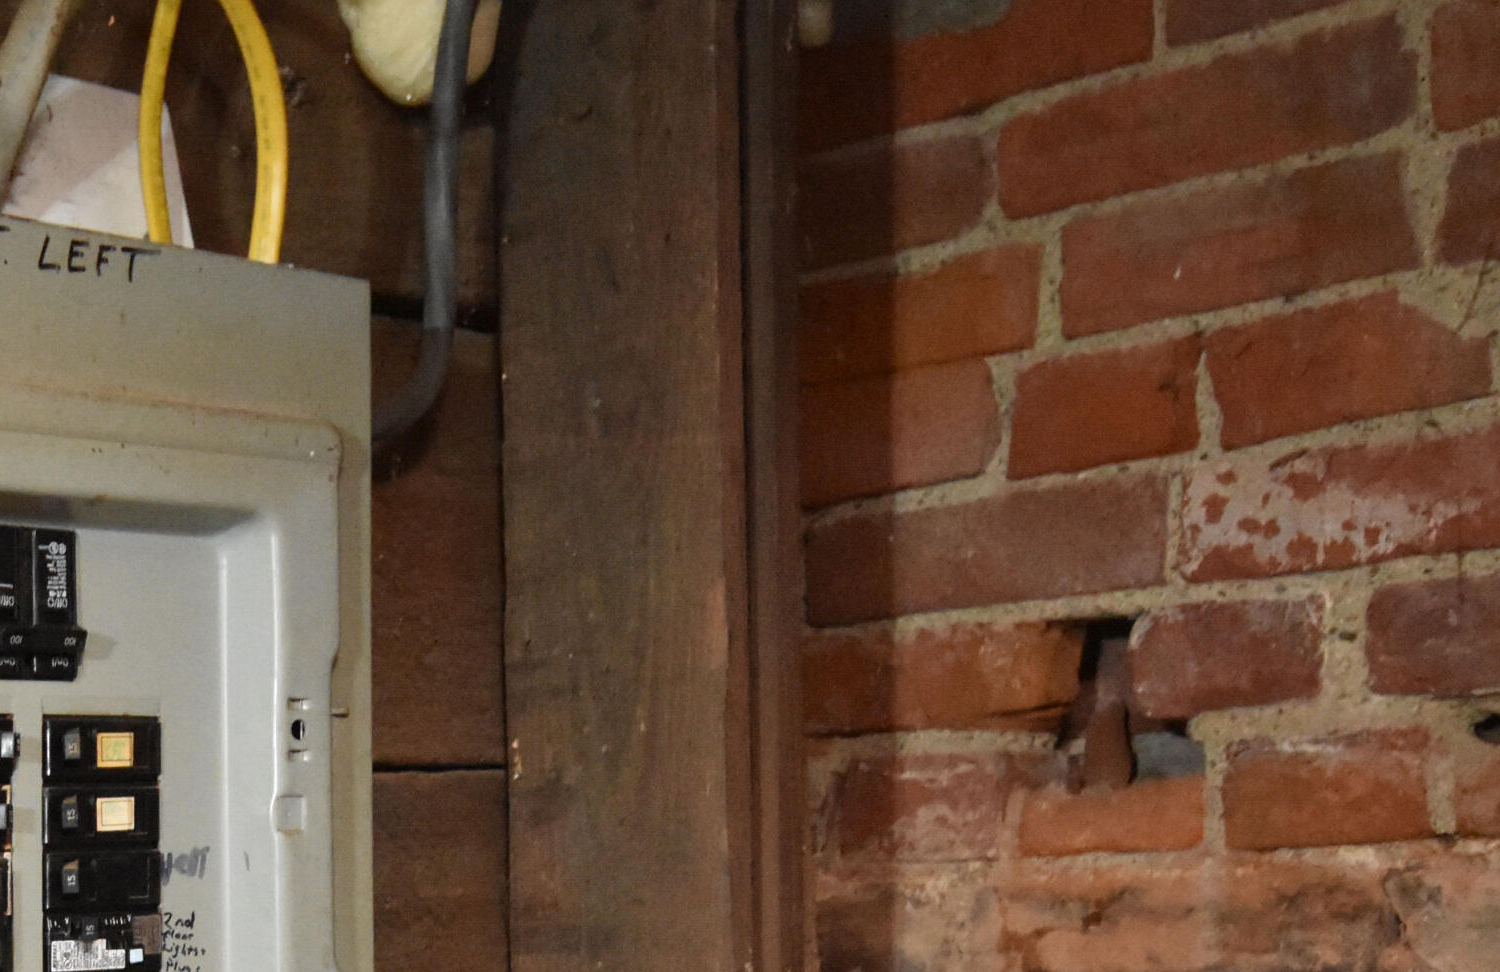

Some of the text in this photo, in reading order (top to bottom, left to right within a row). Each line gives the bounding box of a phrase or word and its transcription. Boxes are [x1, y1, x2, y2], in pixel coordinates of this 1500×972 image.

[38, 234, 161, 283] LEFT
[10, 635, 23, 644] 100
[64, 636, 76, 646] 100
[67, 808, 76, 820] 15
[67, 874, 76, 887] 15
[164, 910, 195, 929] 2nd
[86, 924, 95, 935] 15
